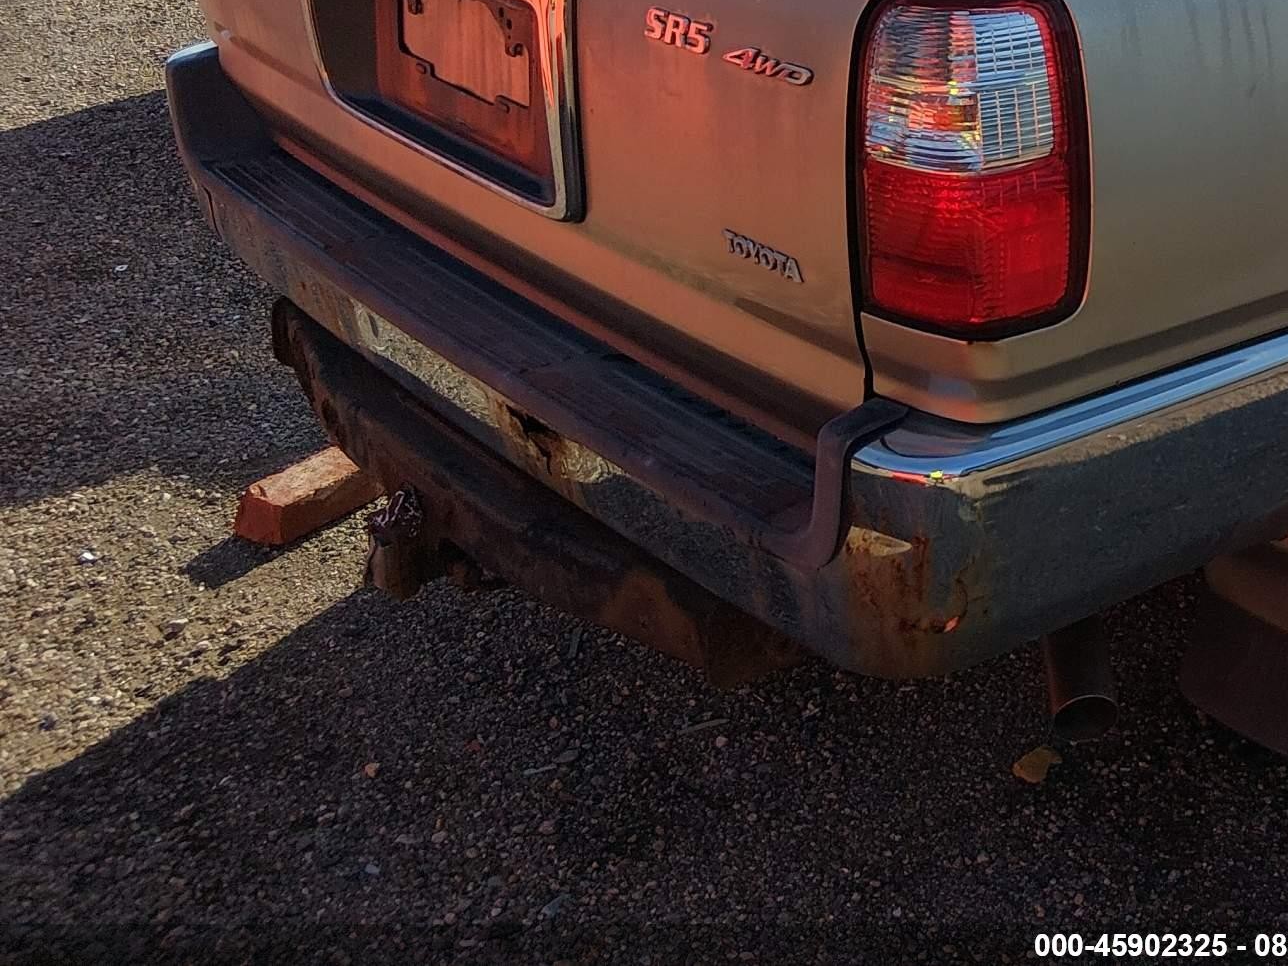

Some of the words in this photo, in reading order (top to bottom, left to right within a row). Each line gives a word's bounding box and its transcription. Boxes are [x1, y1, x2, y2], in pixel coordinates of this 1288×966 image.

[644, 6, 713, 55] SR5
[722, 47, 815, 86] 4WD
[722, 227, 804, 283] TOYOTA
